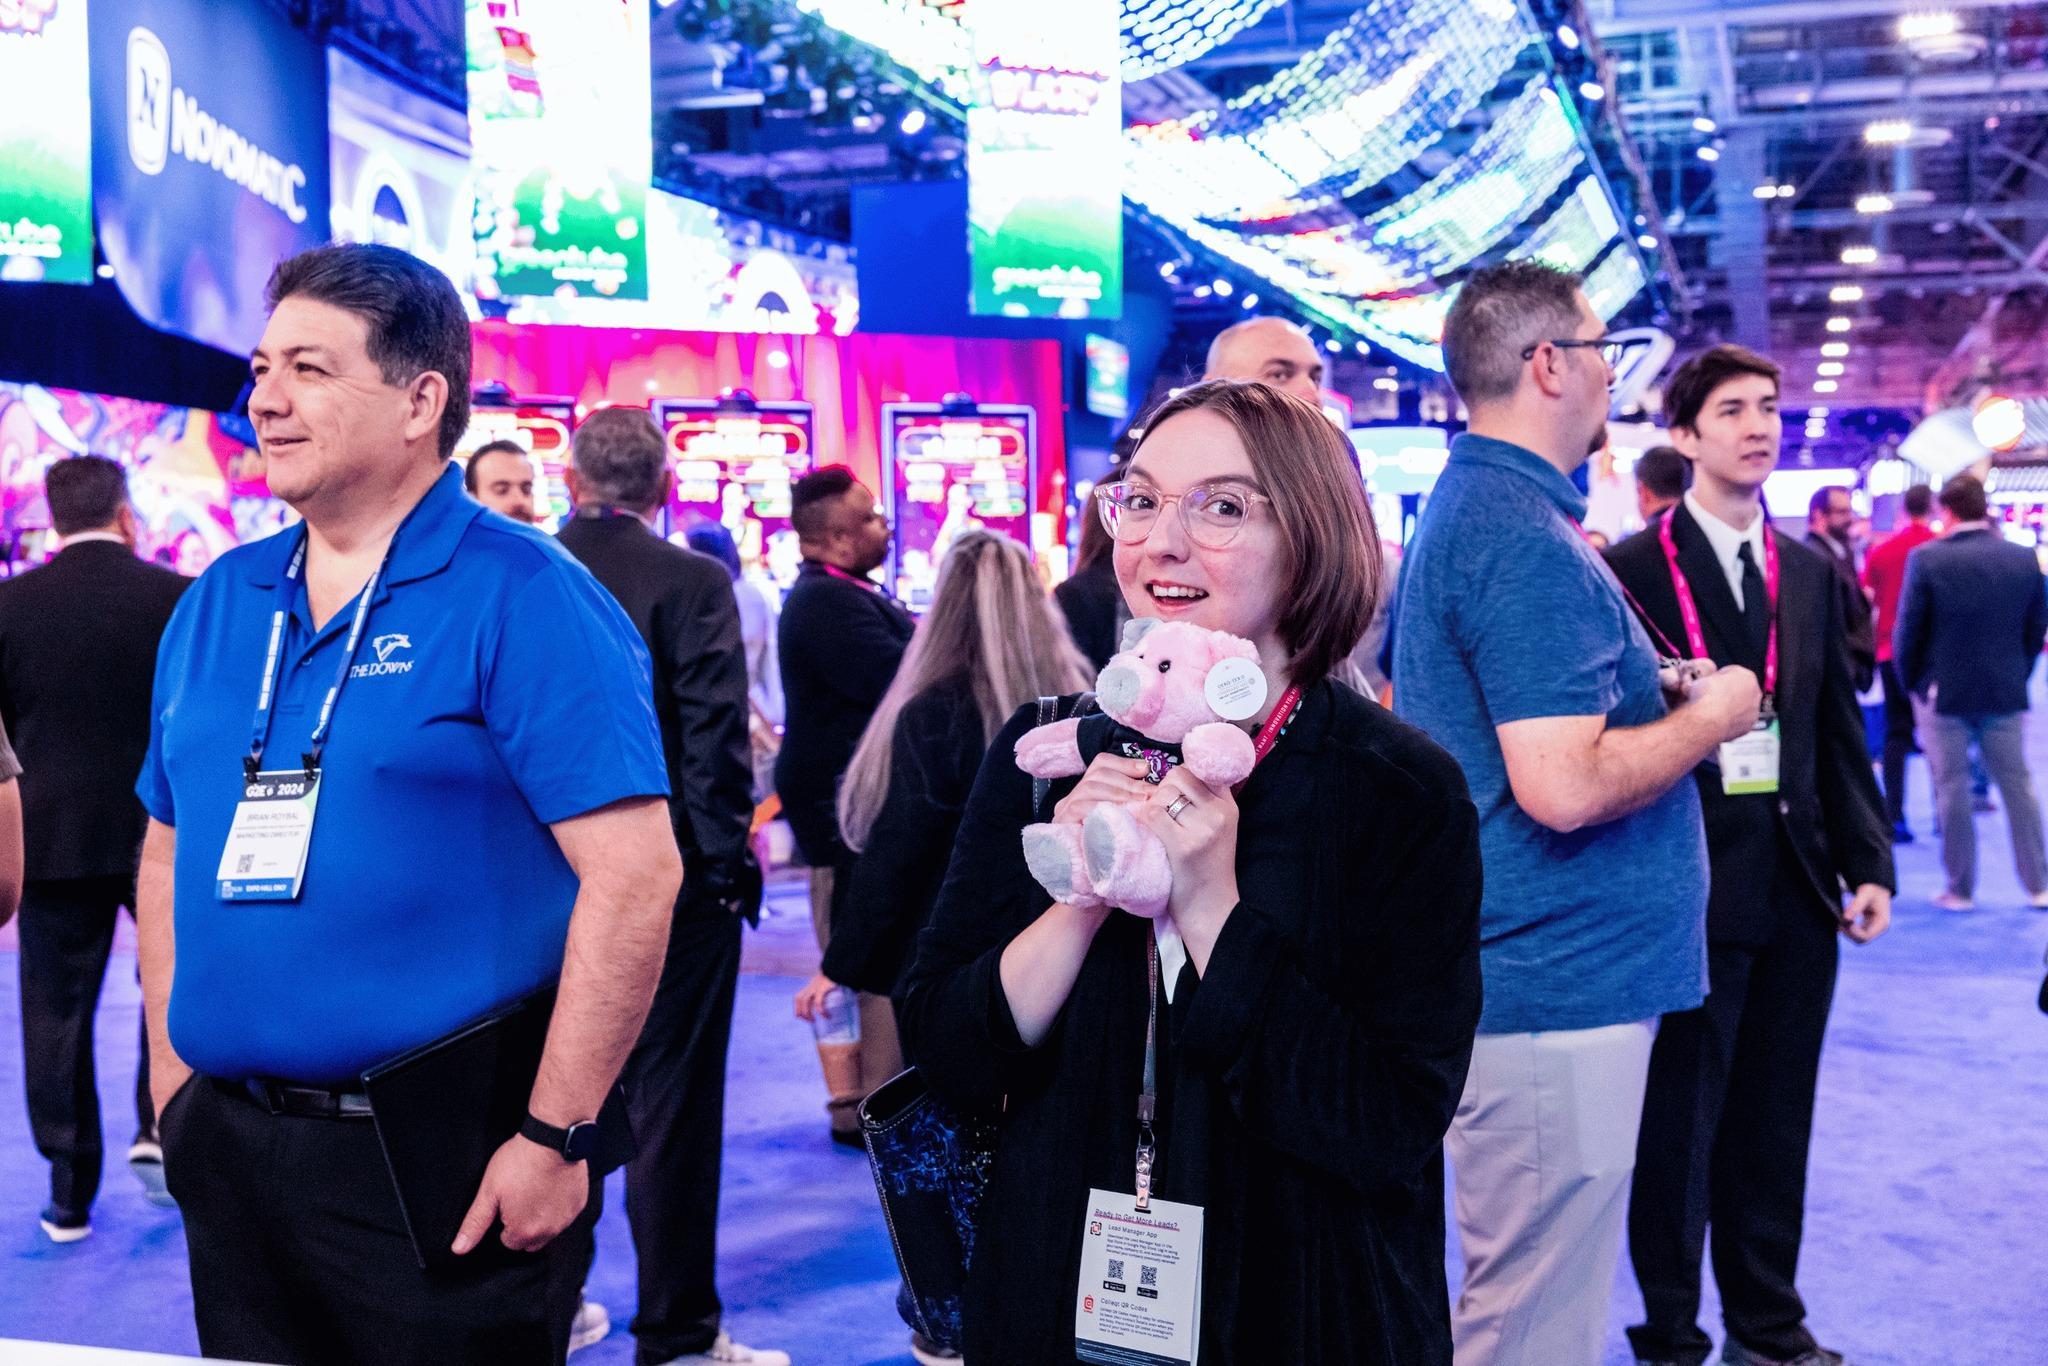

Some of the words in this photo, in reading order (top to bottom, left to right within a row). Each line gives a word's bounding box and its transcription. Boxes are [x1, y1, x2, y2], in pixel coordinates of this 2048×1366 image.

[350, 664, 369, 678] THE
[368, 660, 415, 676] DOWNS
[277, 783, 305, 796] 2024
[1095, 1208, 1114, 1220] Ready
[1115, 1211, 1122, 1219] to
[1124, 1213, 1135, 1221] Get
[1136, 1216, 1153, 1225] More
[1155, 1219, 1178, 1229] Leads?
[1122, 1227, 1146, 1236] Manager
[1147, 1231, 1158, 1239] App
